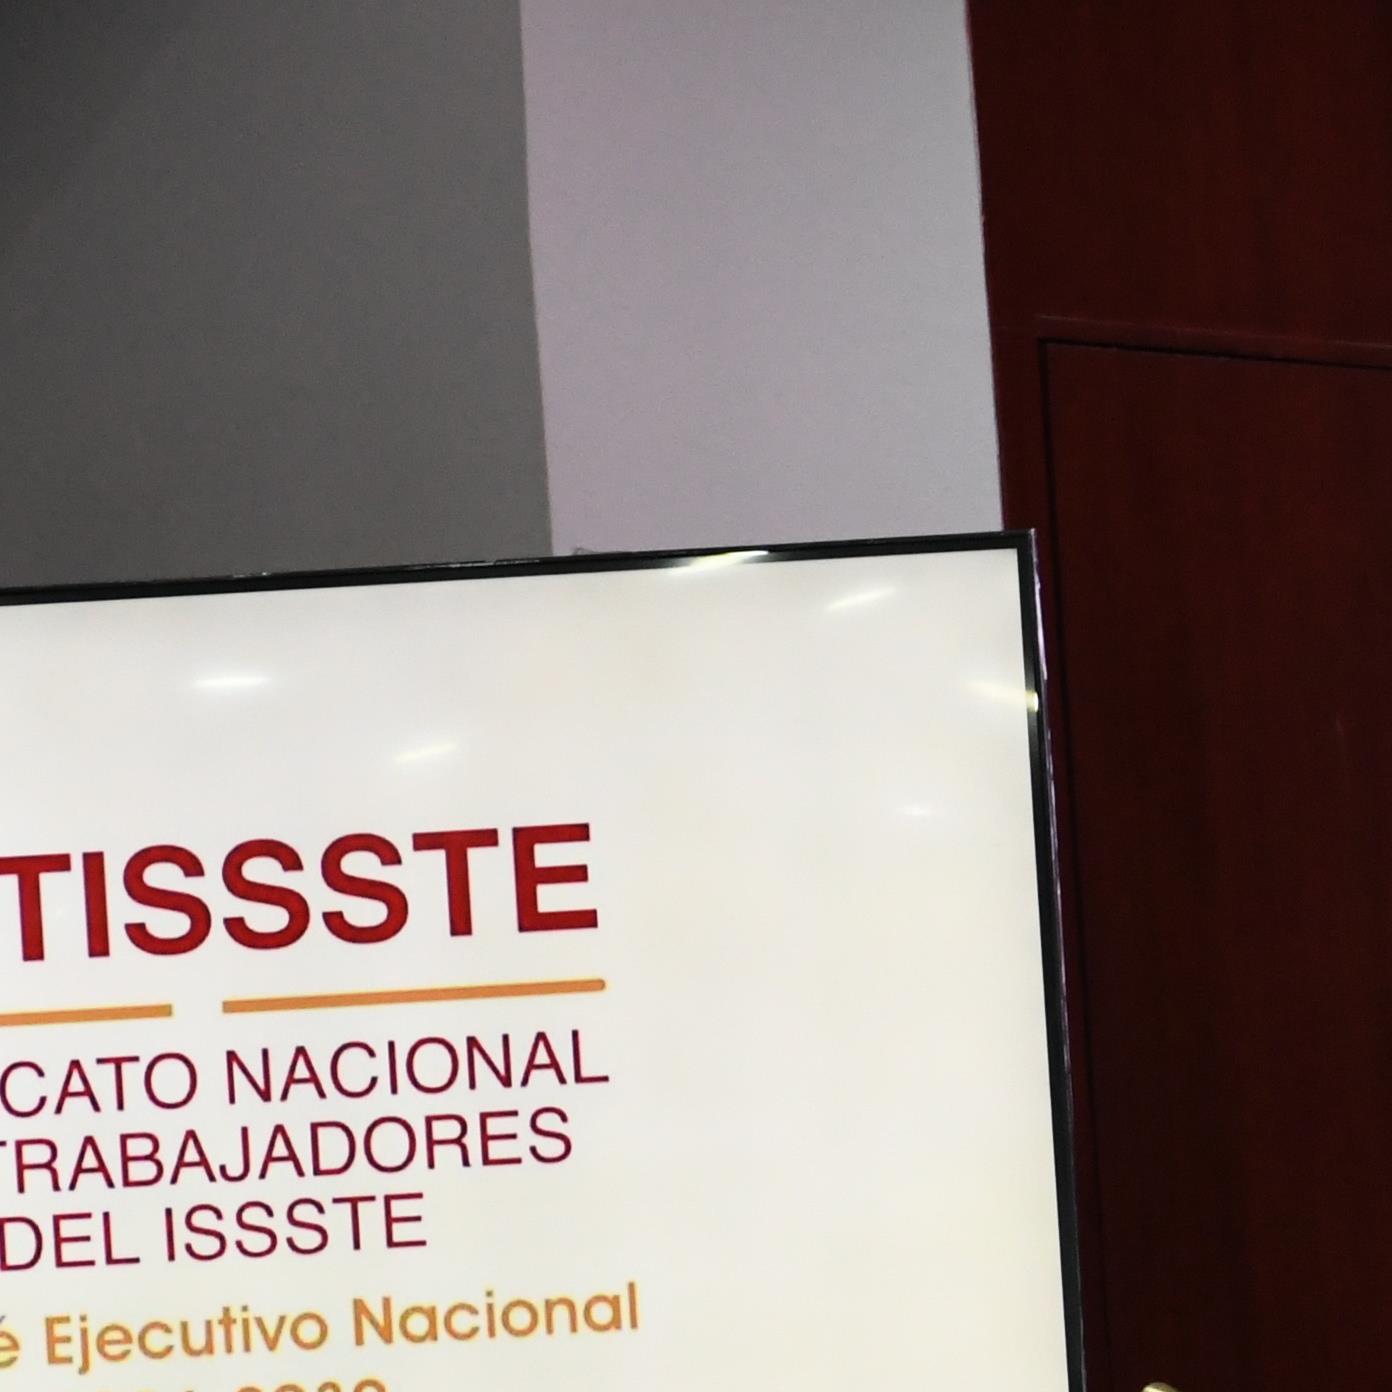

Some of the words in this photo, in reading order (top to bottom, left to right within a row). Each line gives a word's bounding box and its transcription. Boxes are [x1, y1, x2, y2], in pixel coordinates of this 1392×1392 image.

[224, 1030, 610, 1106] NACIONAL
[0, 1107, 572, 1194] RABAJADORES
[0, 1210, 139, 1272] DEL
[164, 1193, 427, 1262] ISSSTE
[45, 1302, 328, 1375] Ejecutivo
[353, 1282, 640, 1348] Nacional
